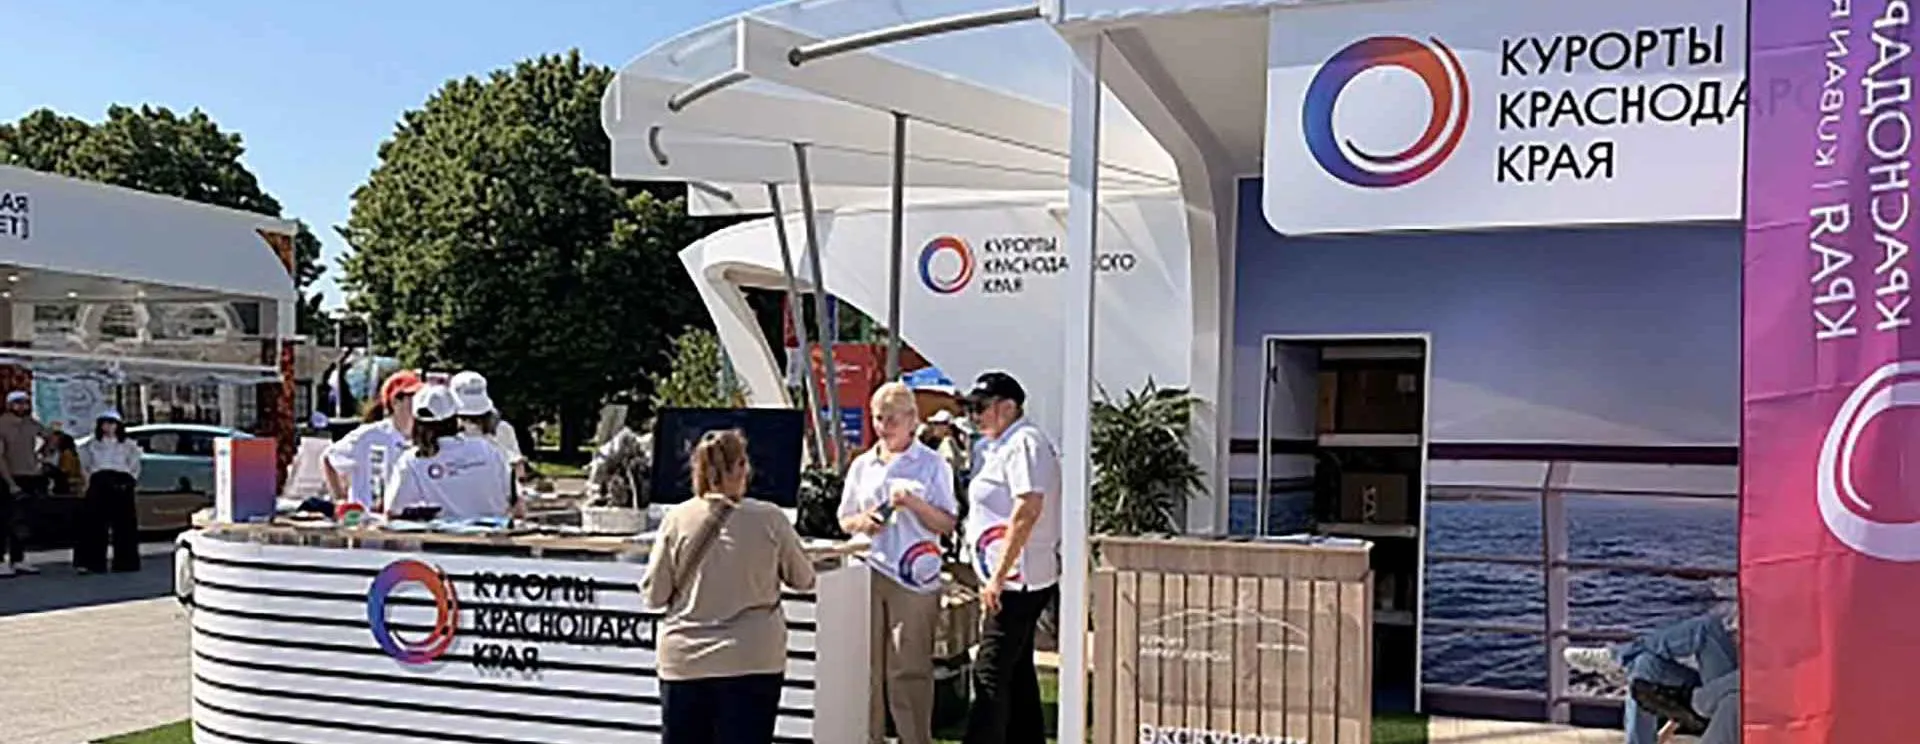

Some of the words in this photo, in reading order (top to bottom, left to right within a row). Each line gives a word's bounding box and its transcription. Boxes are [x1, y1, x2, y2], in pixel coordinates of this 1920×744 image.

[1500, 25, 1724, 76] КУРОРТЫ
[1496, 142, 1614, 183] КРАЯ
[984, 237, 1057, 253] КУРОРТЫ
[472, 571, 595, 603] КУРОРТЫ
[471, 643, 540, 671] КРАЯ
